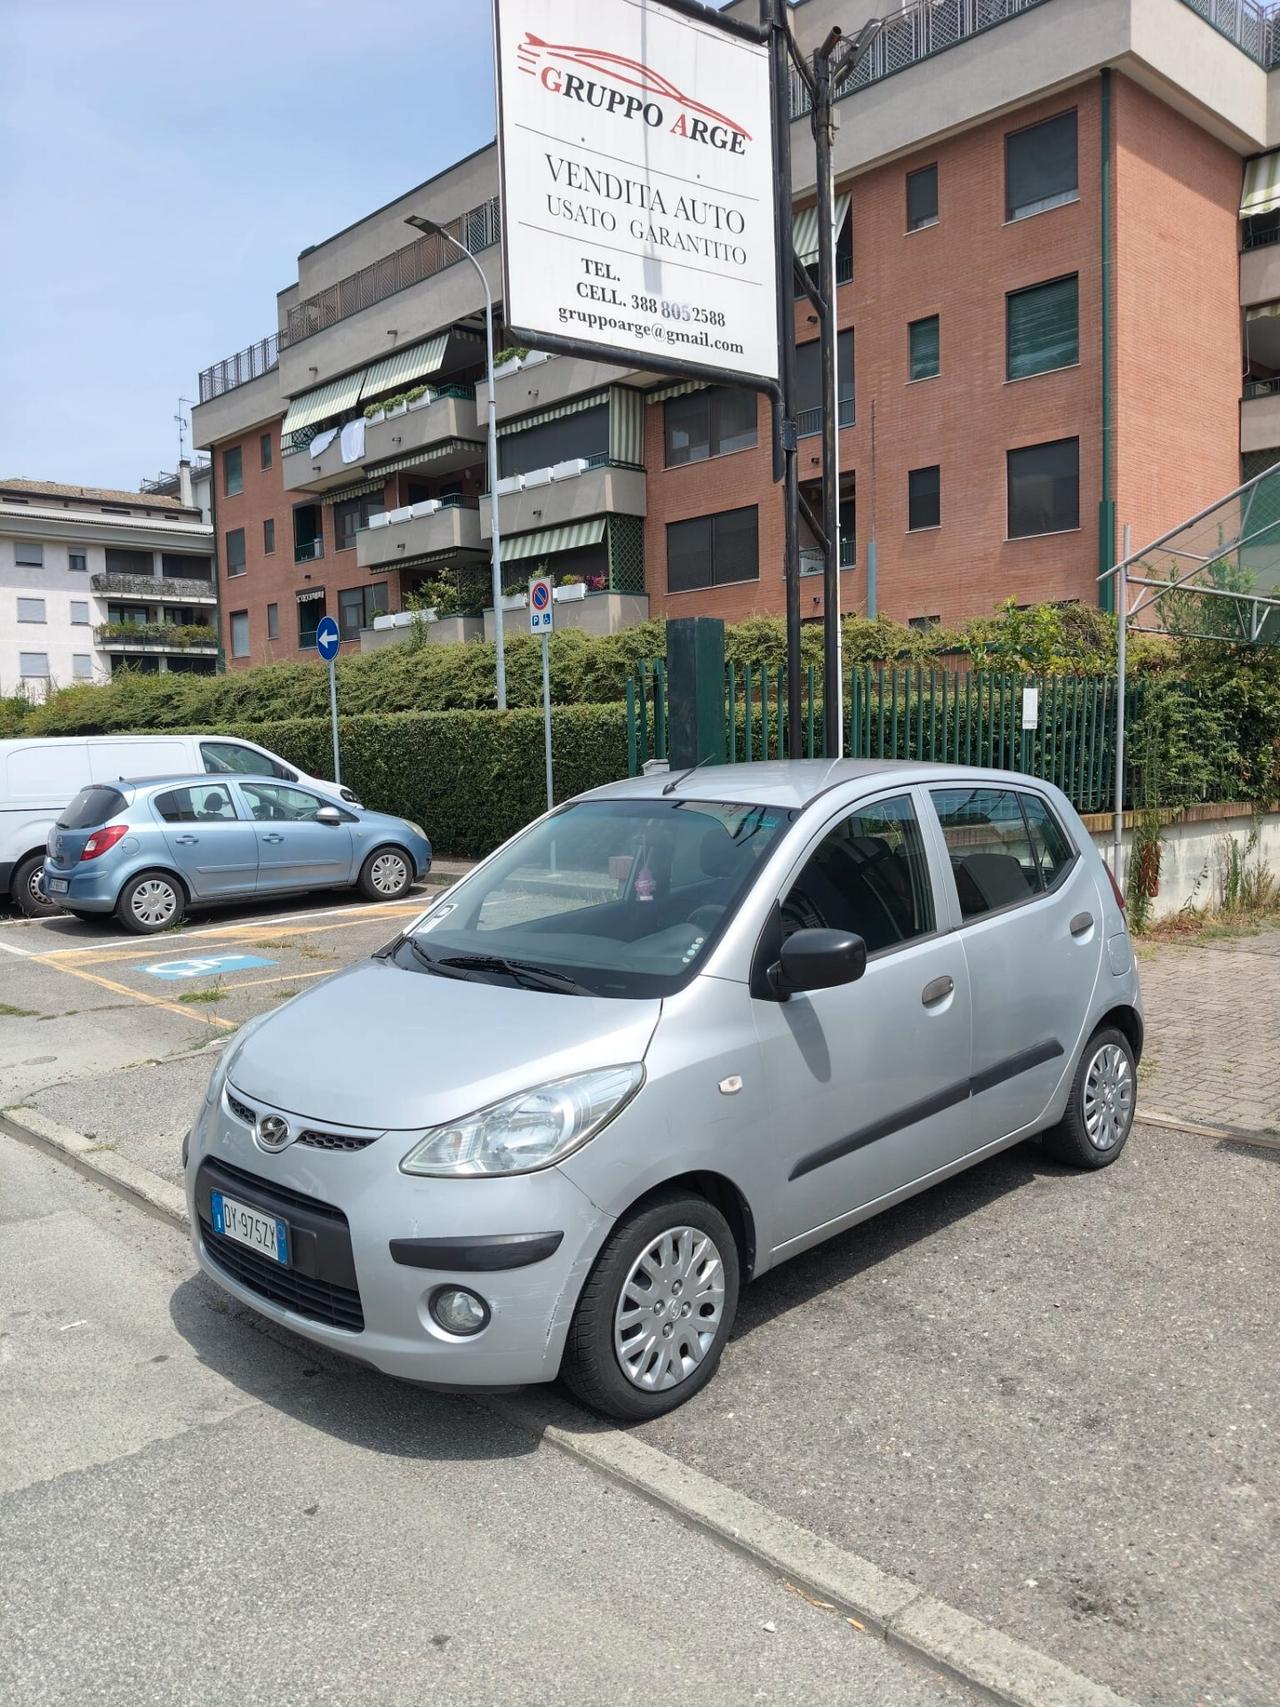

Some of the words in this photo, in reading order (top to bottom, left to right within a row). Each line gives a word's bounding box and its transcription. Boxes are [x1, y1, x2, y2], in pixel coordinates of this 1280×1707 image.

[540, 66, 663, 127] GRUPPO
[670, 113, 747, 155] ARGE
[544, 153, 667, 215] VENDITA
[674, 195, 745, 234] AUTO
[546, 194, 617, 232] USATO
[630, 219, 747, 265] GARANTITO
[576, 282, 627, 307] CELL.
[631, 294, 658, 314] 388
[581, 257, 621, 282] TEL.
[558, 306, 744, 354] gruppoarge@gmail.com
